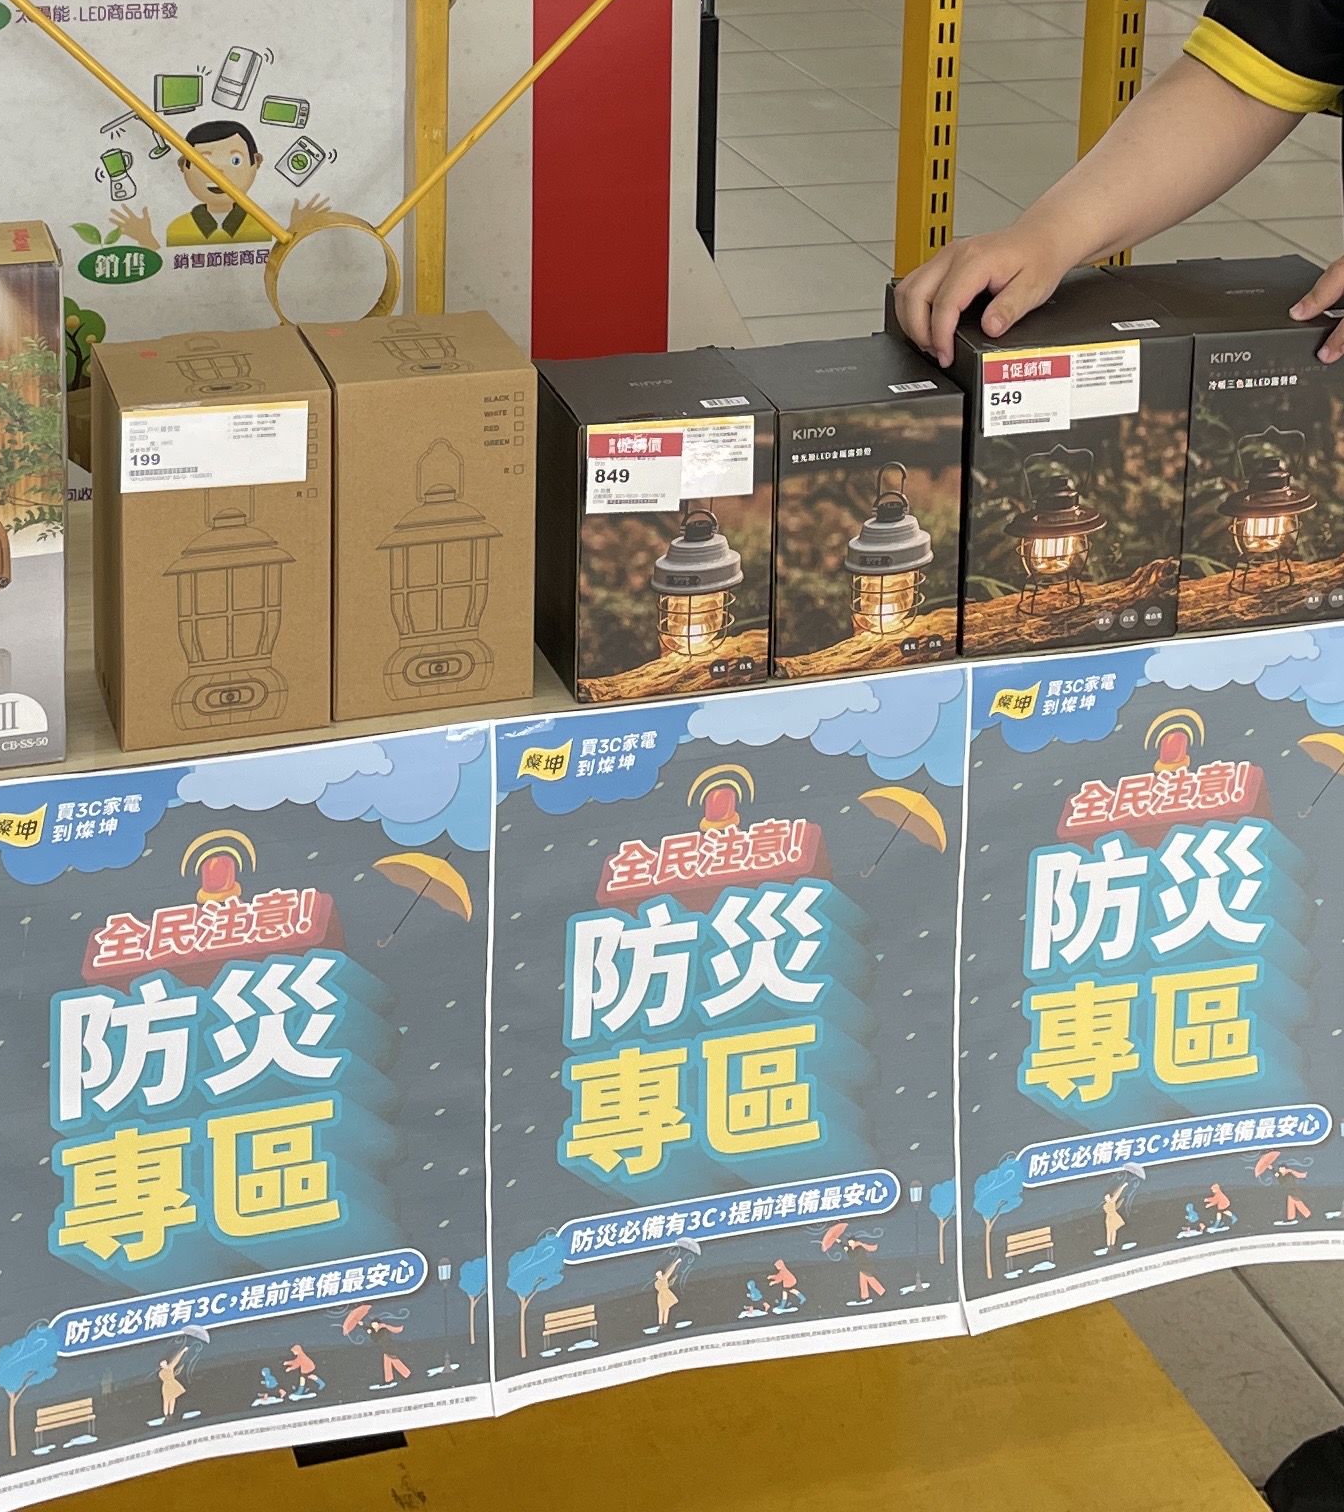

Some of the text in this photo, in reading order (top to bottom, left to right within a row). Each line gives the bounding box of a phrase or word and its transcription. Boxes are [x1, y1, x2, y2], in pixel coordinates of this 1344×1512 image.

[94, 252, 147, 279] 銷售
[1010, 360, 1054, 378] 促銷價
[1209, 350, 1252, 364] KINYO
[483, 394, 511, 404] BLACK
[989, 390, 1023, 406] 549
[483, 408, 509, 419] WHITE
[483, 423, 501, 434] RED
[791, 426, 837, 441] KINYO
[483, 437, 511, 447] GREEN
[130, 453, 161, 467] 199
[594, 468, 631, 484] 849
[1046, 672, 1117, 698] 買3C家電
[997, 693, 1033, 714] 燦坤
[1042, 695, 1096, 717] 到燦坤
[579, 730, 658, 758] 買3C家電
[524, 753, 563, 775] 燦坤
[576, 754, 636, 778] 到燦坤
[1066, 760, 1250, 828] 全民注意!
[55, 794, 143, 821] 買3C家電
[52, 818, 119, 844] 到燦坤
[606, 818, 807, 892] 全民注意!
[1030, 824, 1267, 971] 防災
[92, 888, 317, 967] 全民注意!
[571, 885, 825, 1040] 防災
[59, 958, 343, 1122] 防災
[1025, 963, 1258, 1103] 專區
[566, 1024, 820, 1176] 專區
[58, 1100, 341, 1262] 專區
